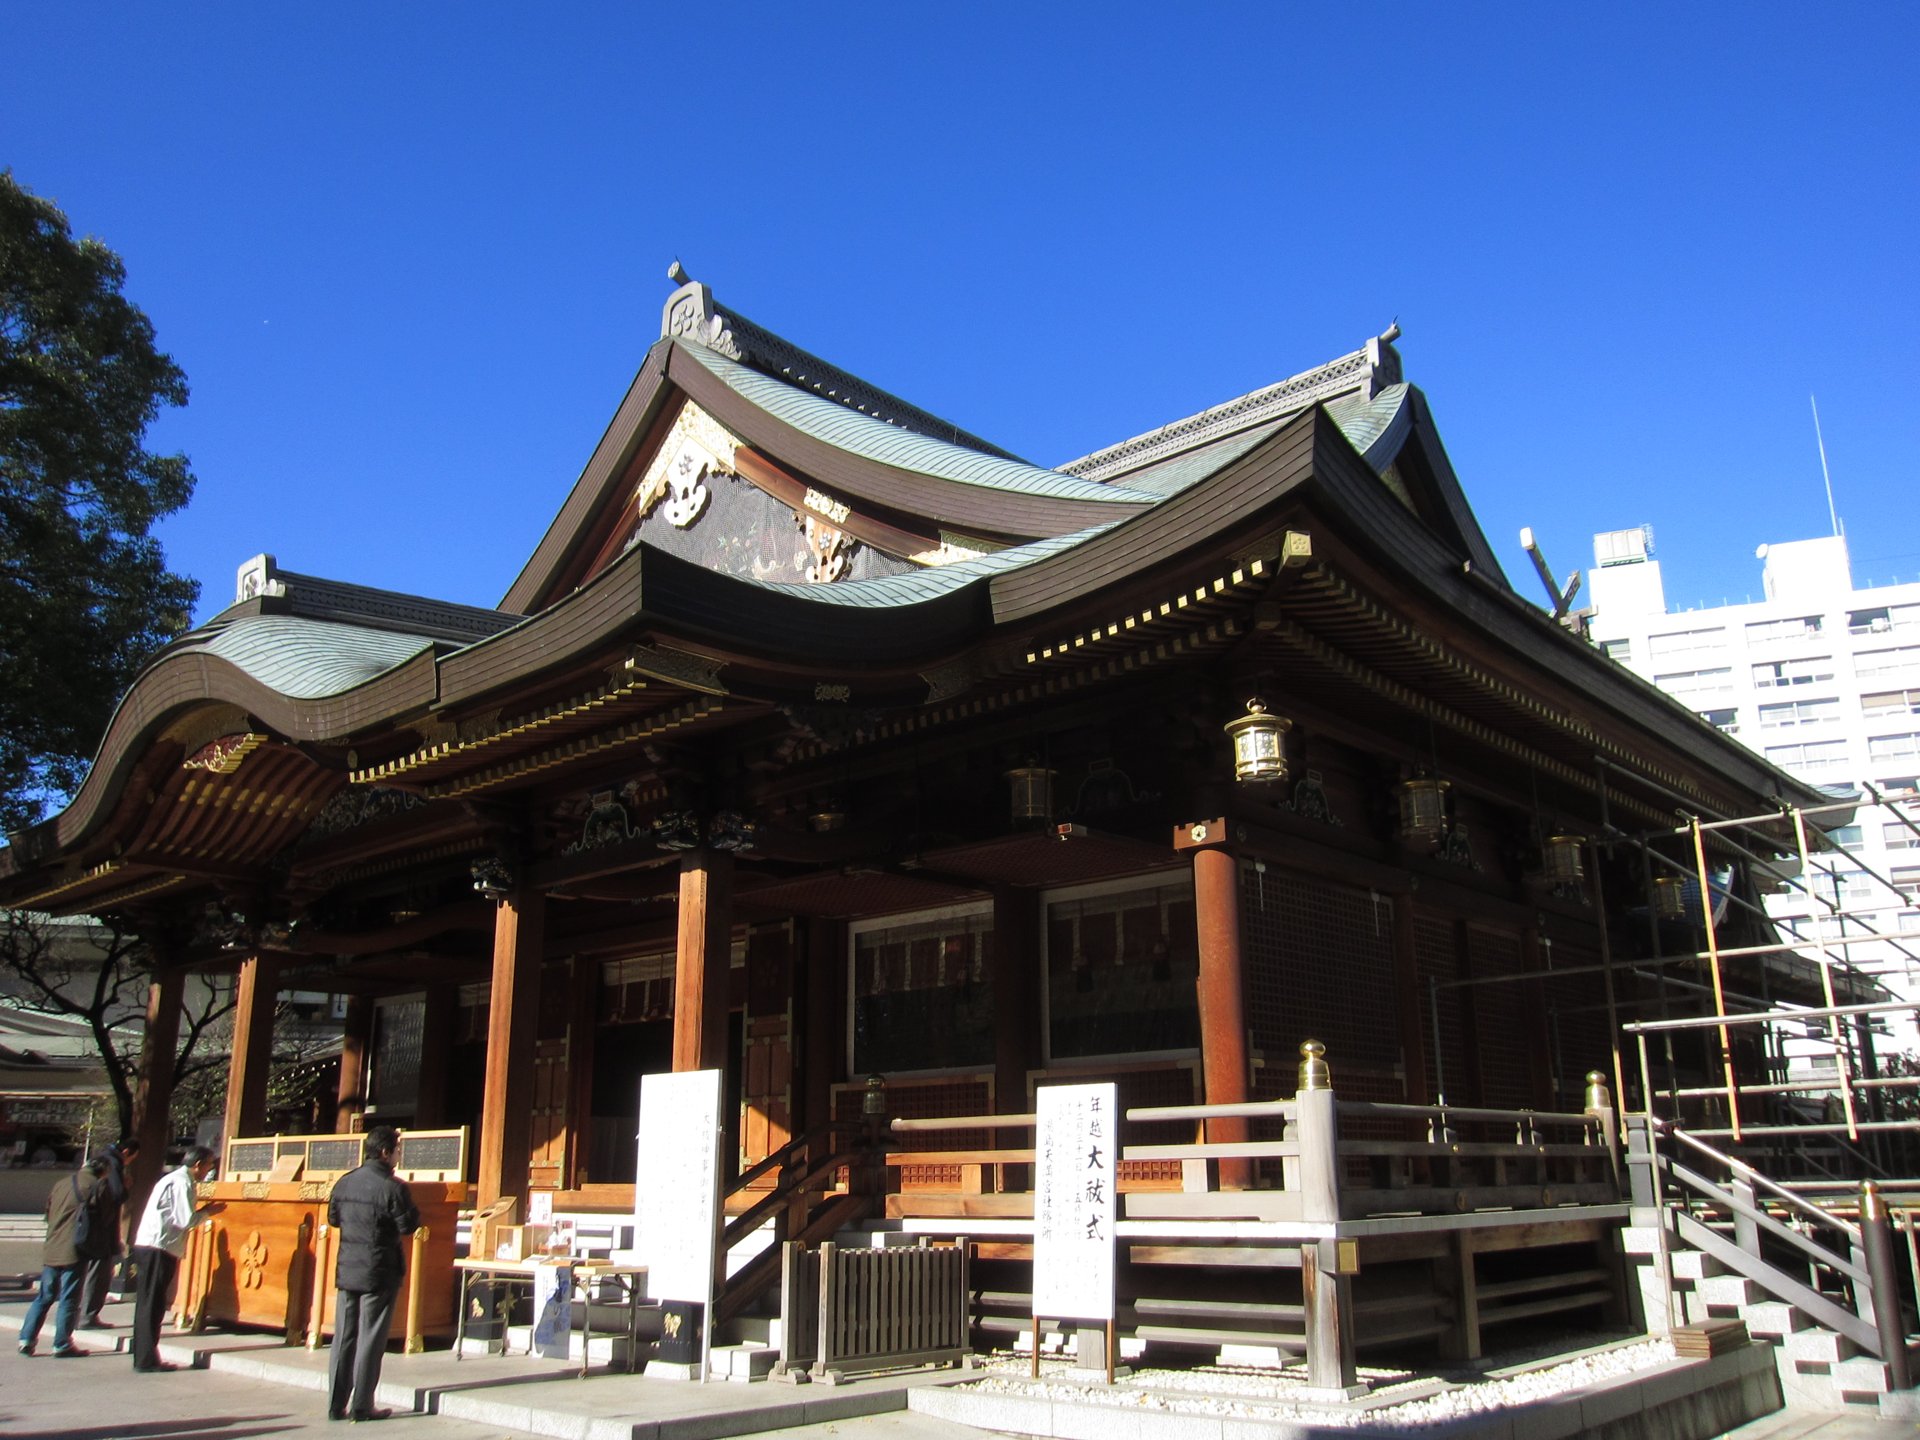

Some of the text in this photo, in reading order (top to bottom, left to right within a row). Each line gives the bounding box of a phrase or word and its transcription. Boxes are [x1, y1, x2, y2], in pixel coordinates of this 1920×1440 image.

[1085, 1096, 1106, 1242] 年越大祓式
